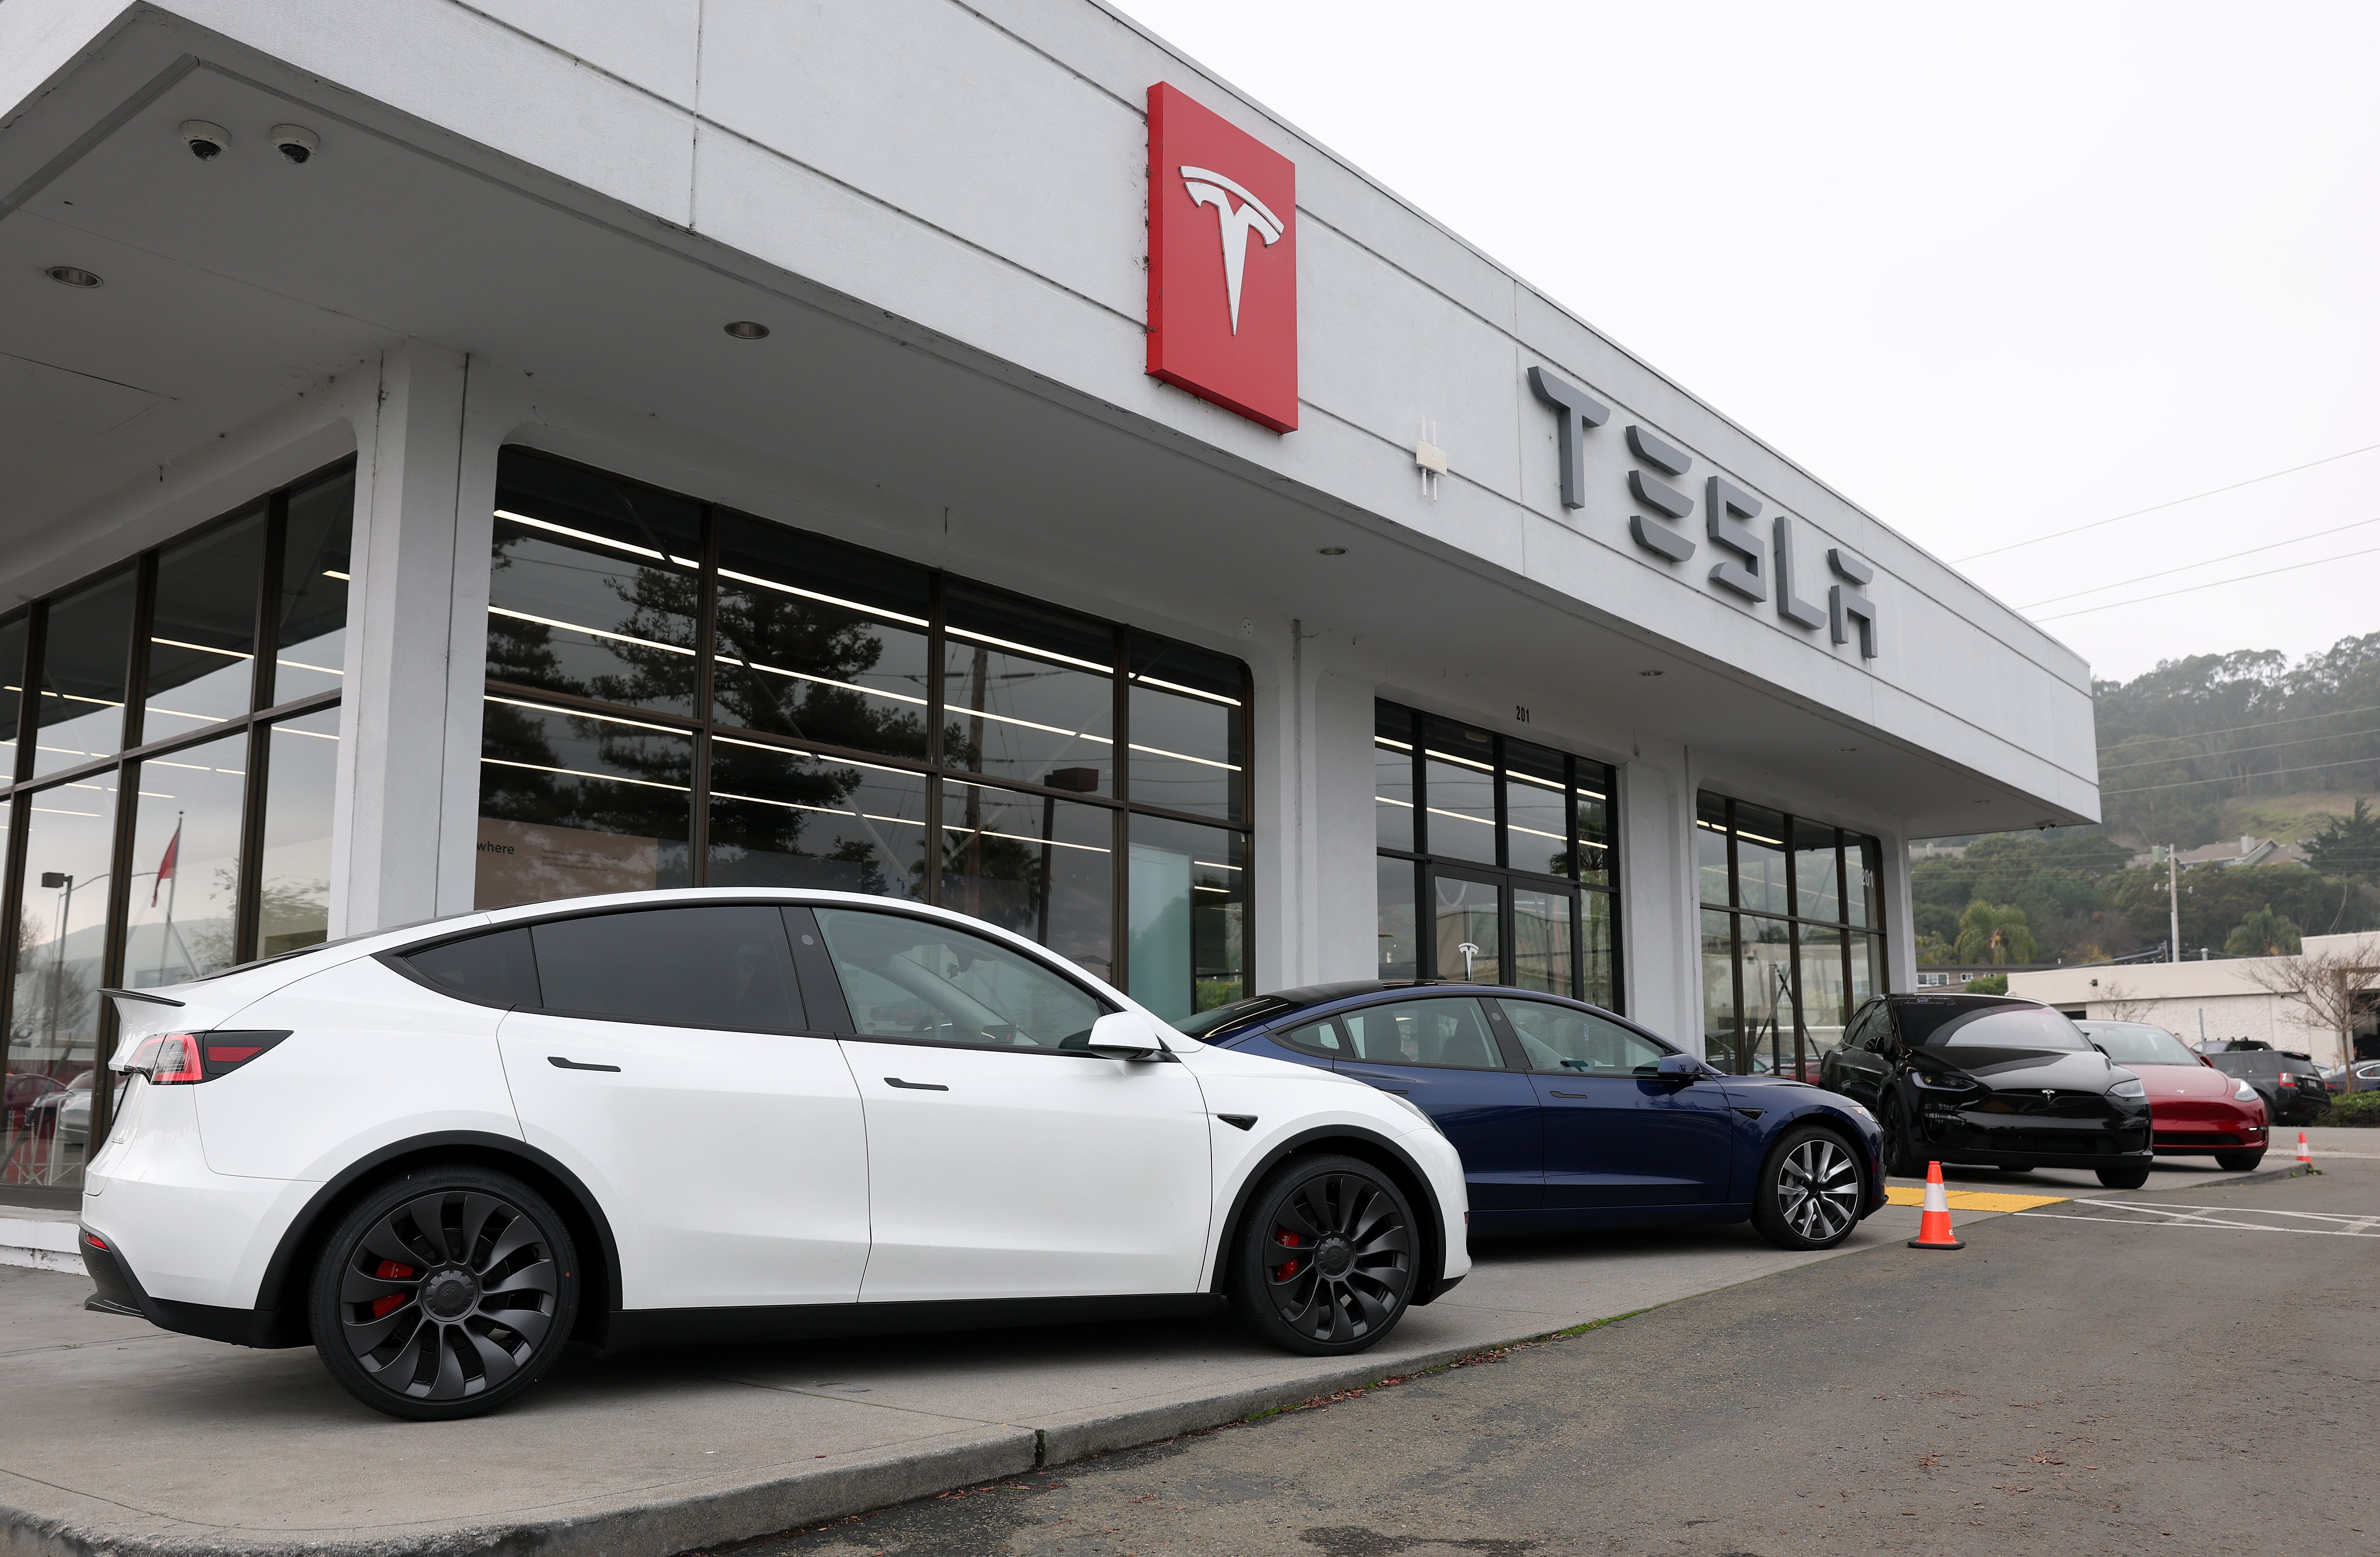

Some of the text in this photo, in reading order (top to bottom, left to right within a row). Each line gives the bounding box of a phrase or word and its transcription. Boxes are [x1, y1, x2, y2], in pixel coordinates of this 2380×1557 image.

[1528, 366, 1878, 658] TESLA
[1516, 705, 1529, 723] 201
[1861, 868, 1873, 887] 201
